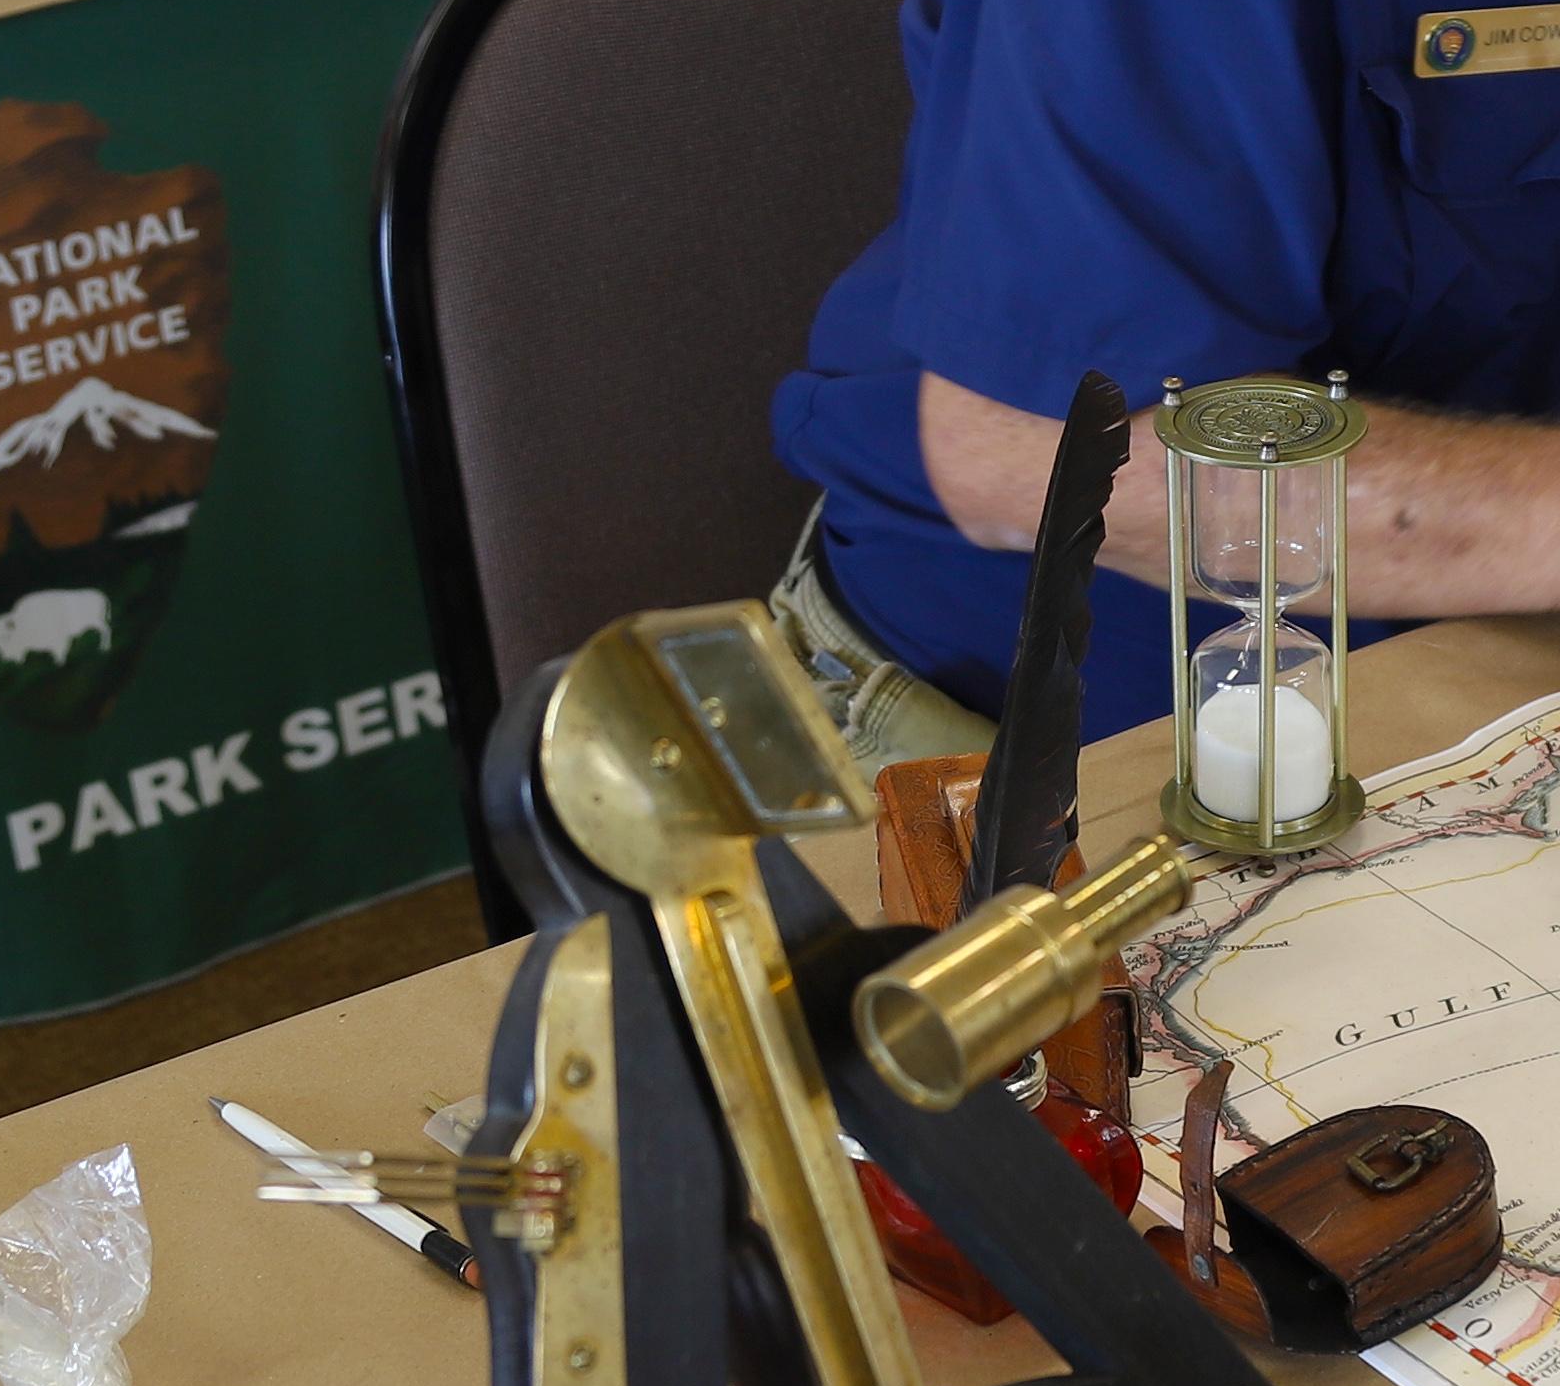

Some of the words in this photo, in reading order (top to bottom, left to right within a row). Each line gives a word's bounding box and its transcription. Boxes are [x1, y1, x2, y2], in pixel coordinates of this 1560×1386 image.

[1484, 31, 1515, 46] JIM
[9, 265, 148, 334] PARK
[9, 730, 264, 873] PARK
[282, 671, 447, 773] SER
[1335, 980, 1513, 1046] GULF
